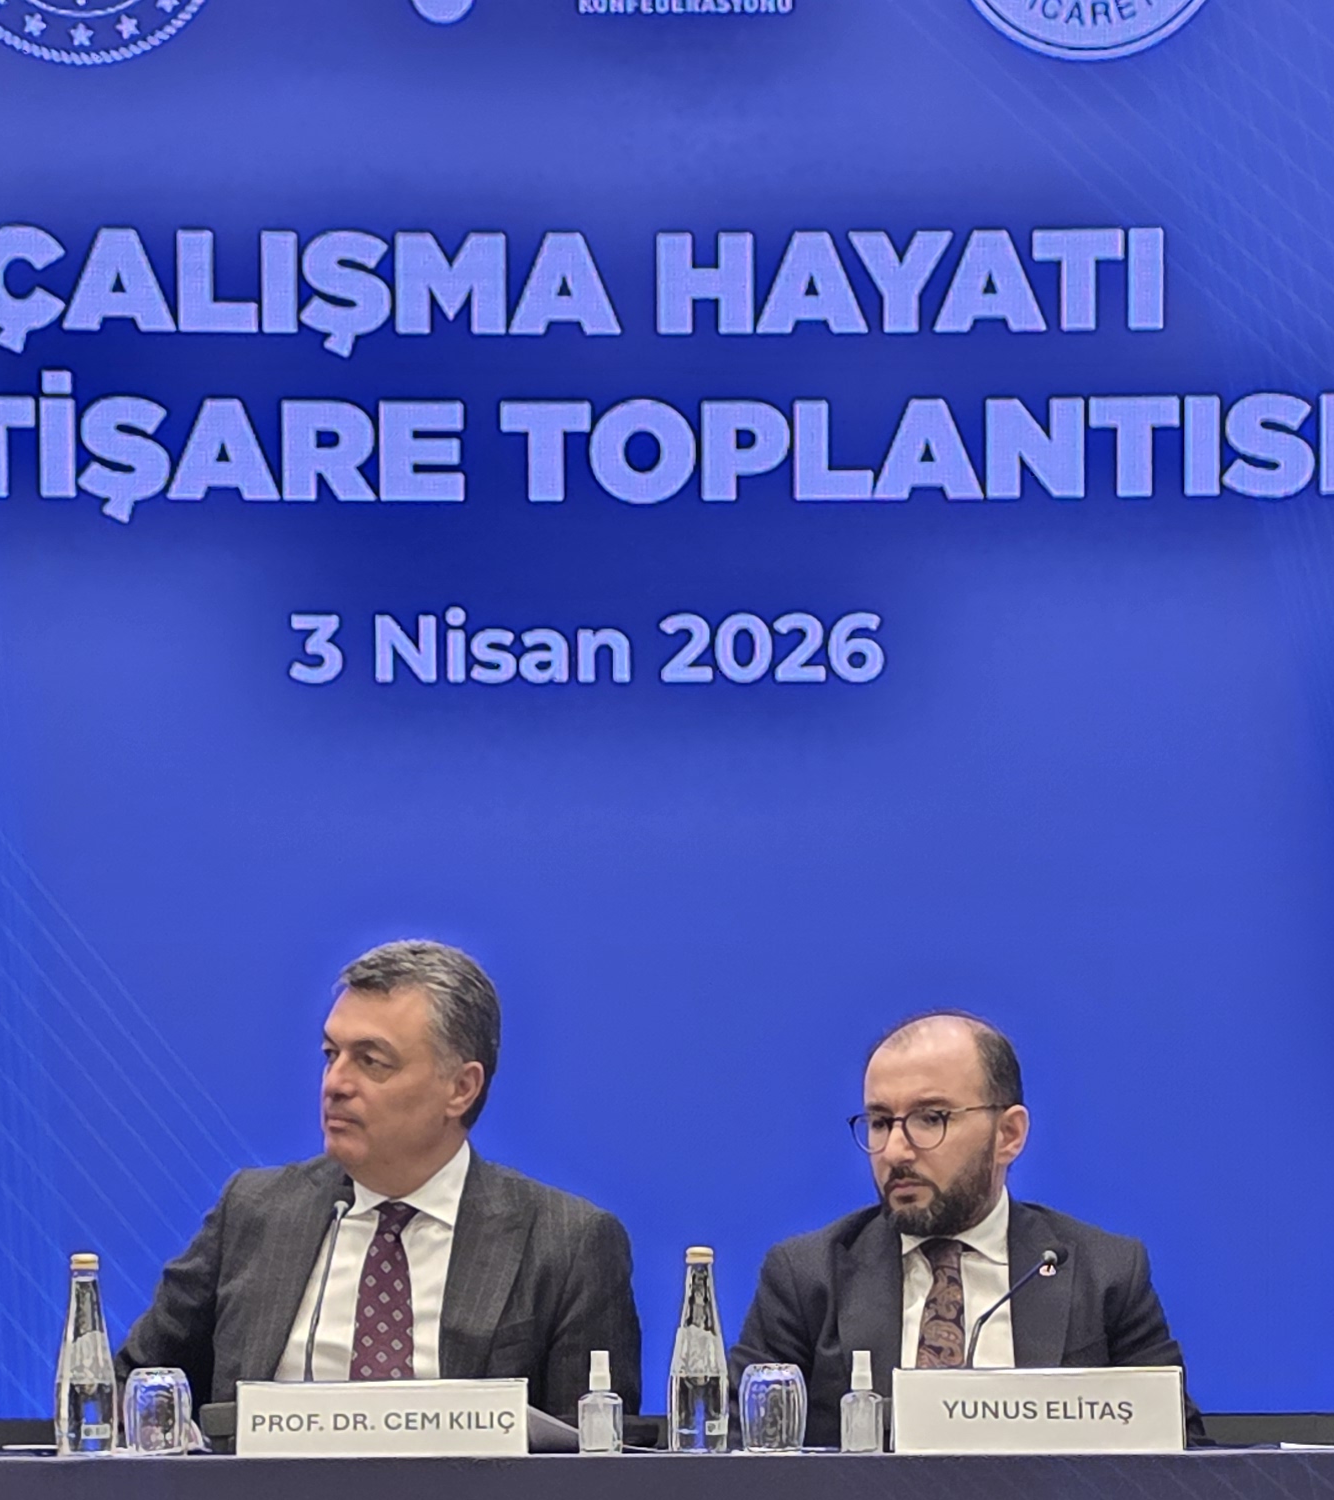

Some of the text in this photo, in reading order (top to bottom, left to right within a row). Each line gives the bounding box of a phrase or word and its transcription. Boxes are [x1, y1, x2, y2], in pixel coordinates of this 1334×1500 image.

[656, 226, 1165, 334] HAYATI
[289, 606, 885, 684] 3 Nisan 2026
[251, 1411, 515, 1435] PROF. DR. CEM KILIÇ
[942, 1396, 1133, 1426] YUNUS ELİTAŞ
